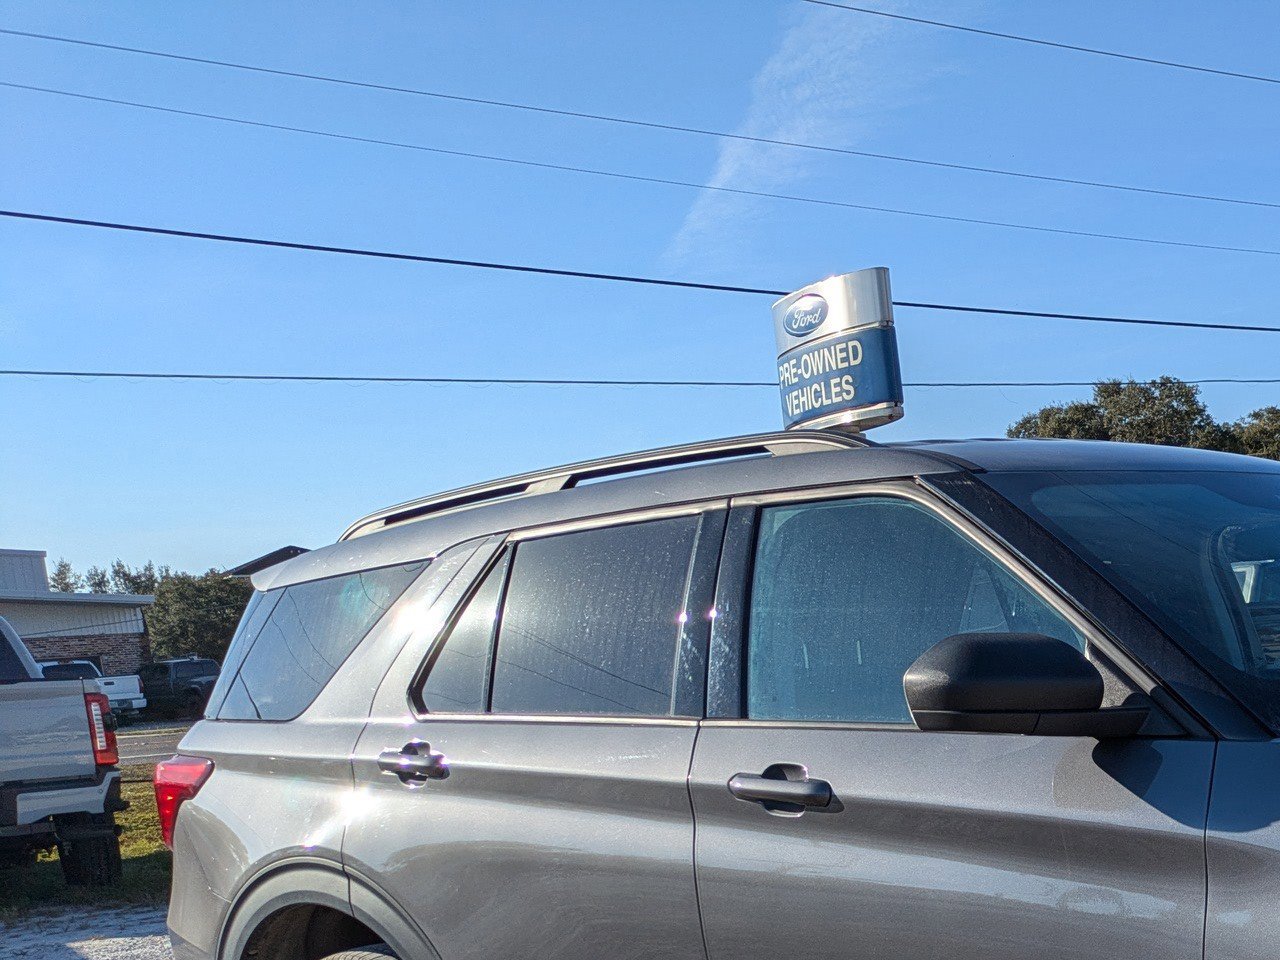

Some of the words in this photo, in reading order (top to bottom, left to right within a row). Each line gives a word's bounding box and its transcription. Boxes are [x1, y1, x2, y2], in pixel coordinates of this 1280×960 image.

[792, 308, 822, 330] Ford
[779, 340, 863, 389] PRE-OWNED
[786, 374, 855, 417] VEHICLES
